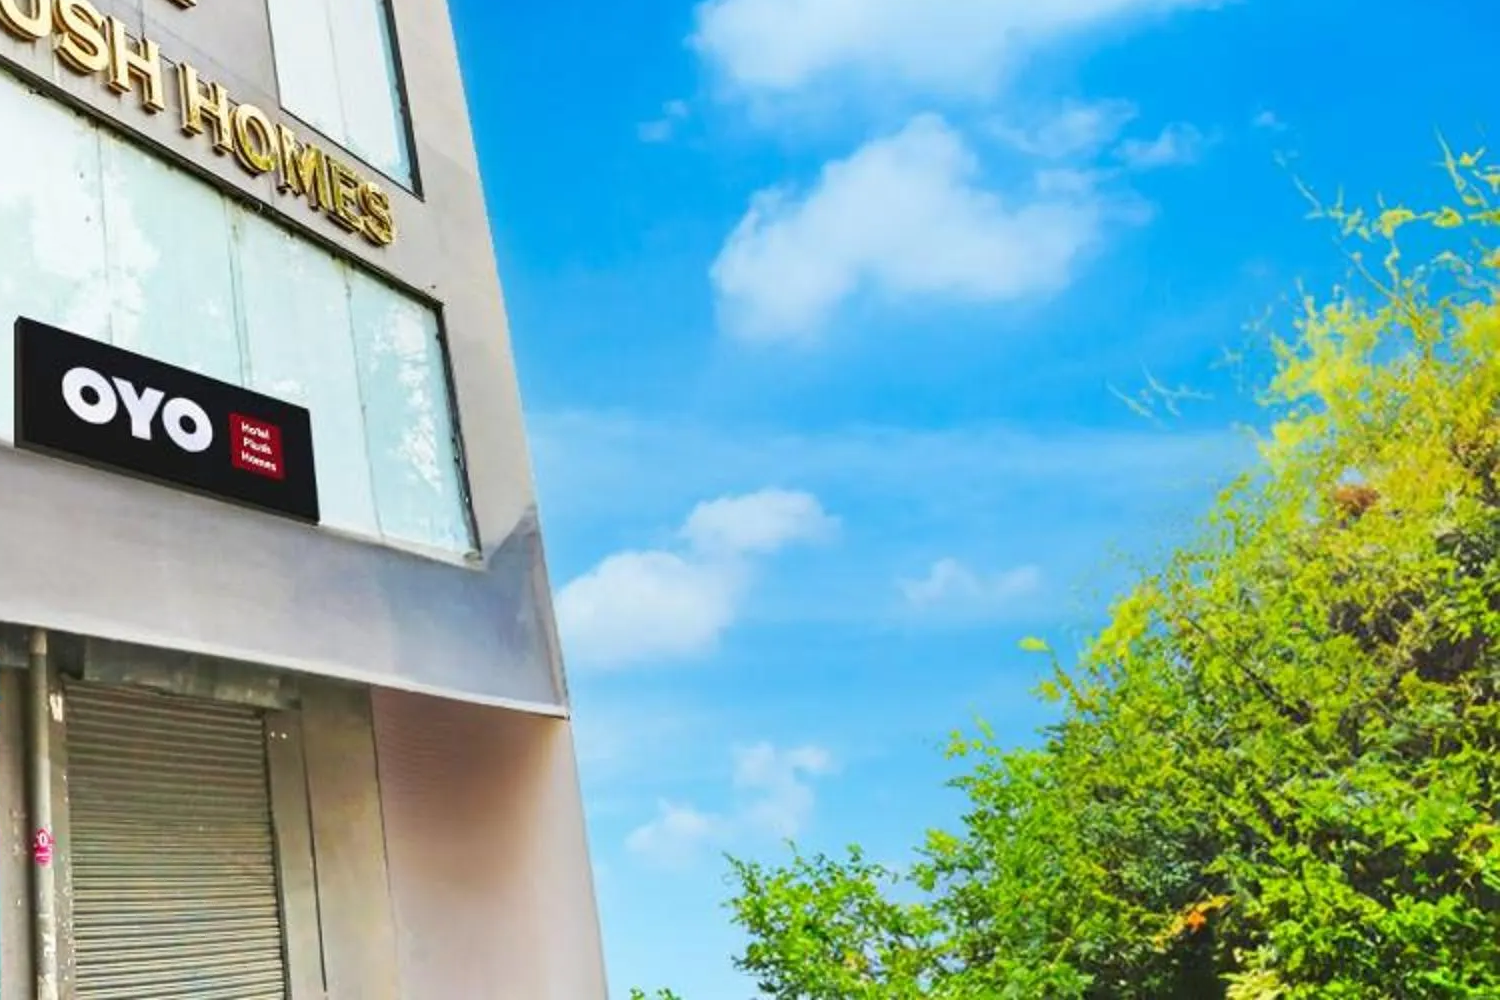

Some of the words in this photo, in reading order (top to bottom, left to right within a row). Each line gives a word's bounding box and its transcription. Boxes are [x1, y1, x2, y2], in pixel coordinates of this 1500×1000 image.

[177, 60, 397, 248] HOMES
[61, 366, 214, 453] OYO
[241, 421, 270, 440] Hotel
[243, 436, 273, 455] Plush
[241, 450, 277, 472] Homes
